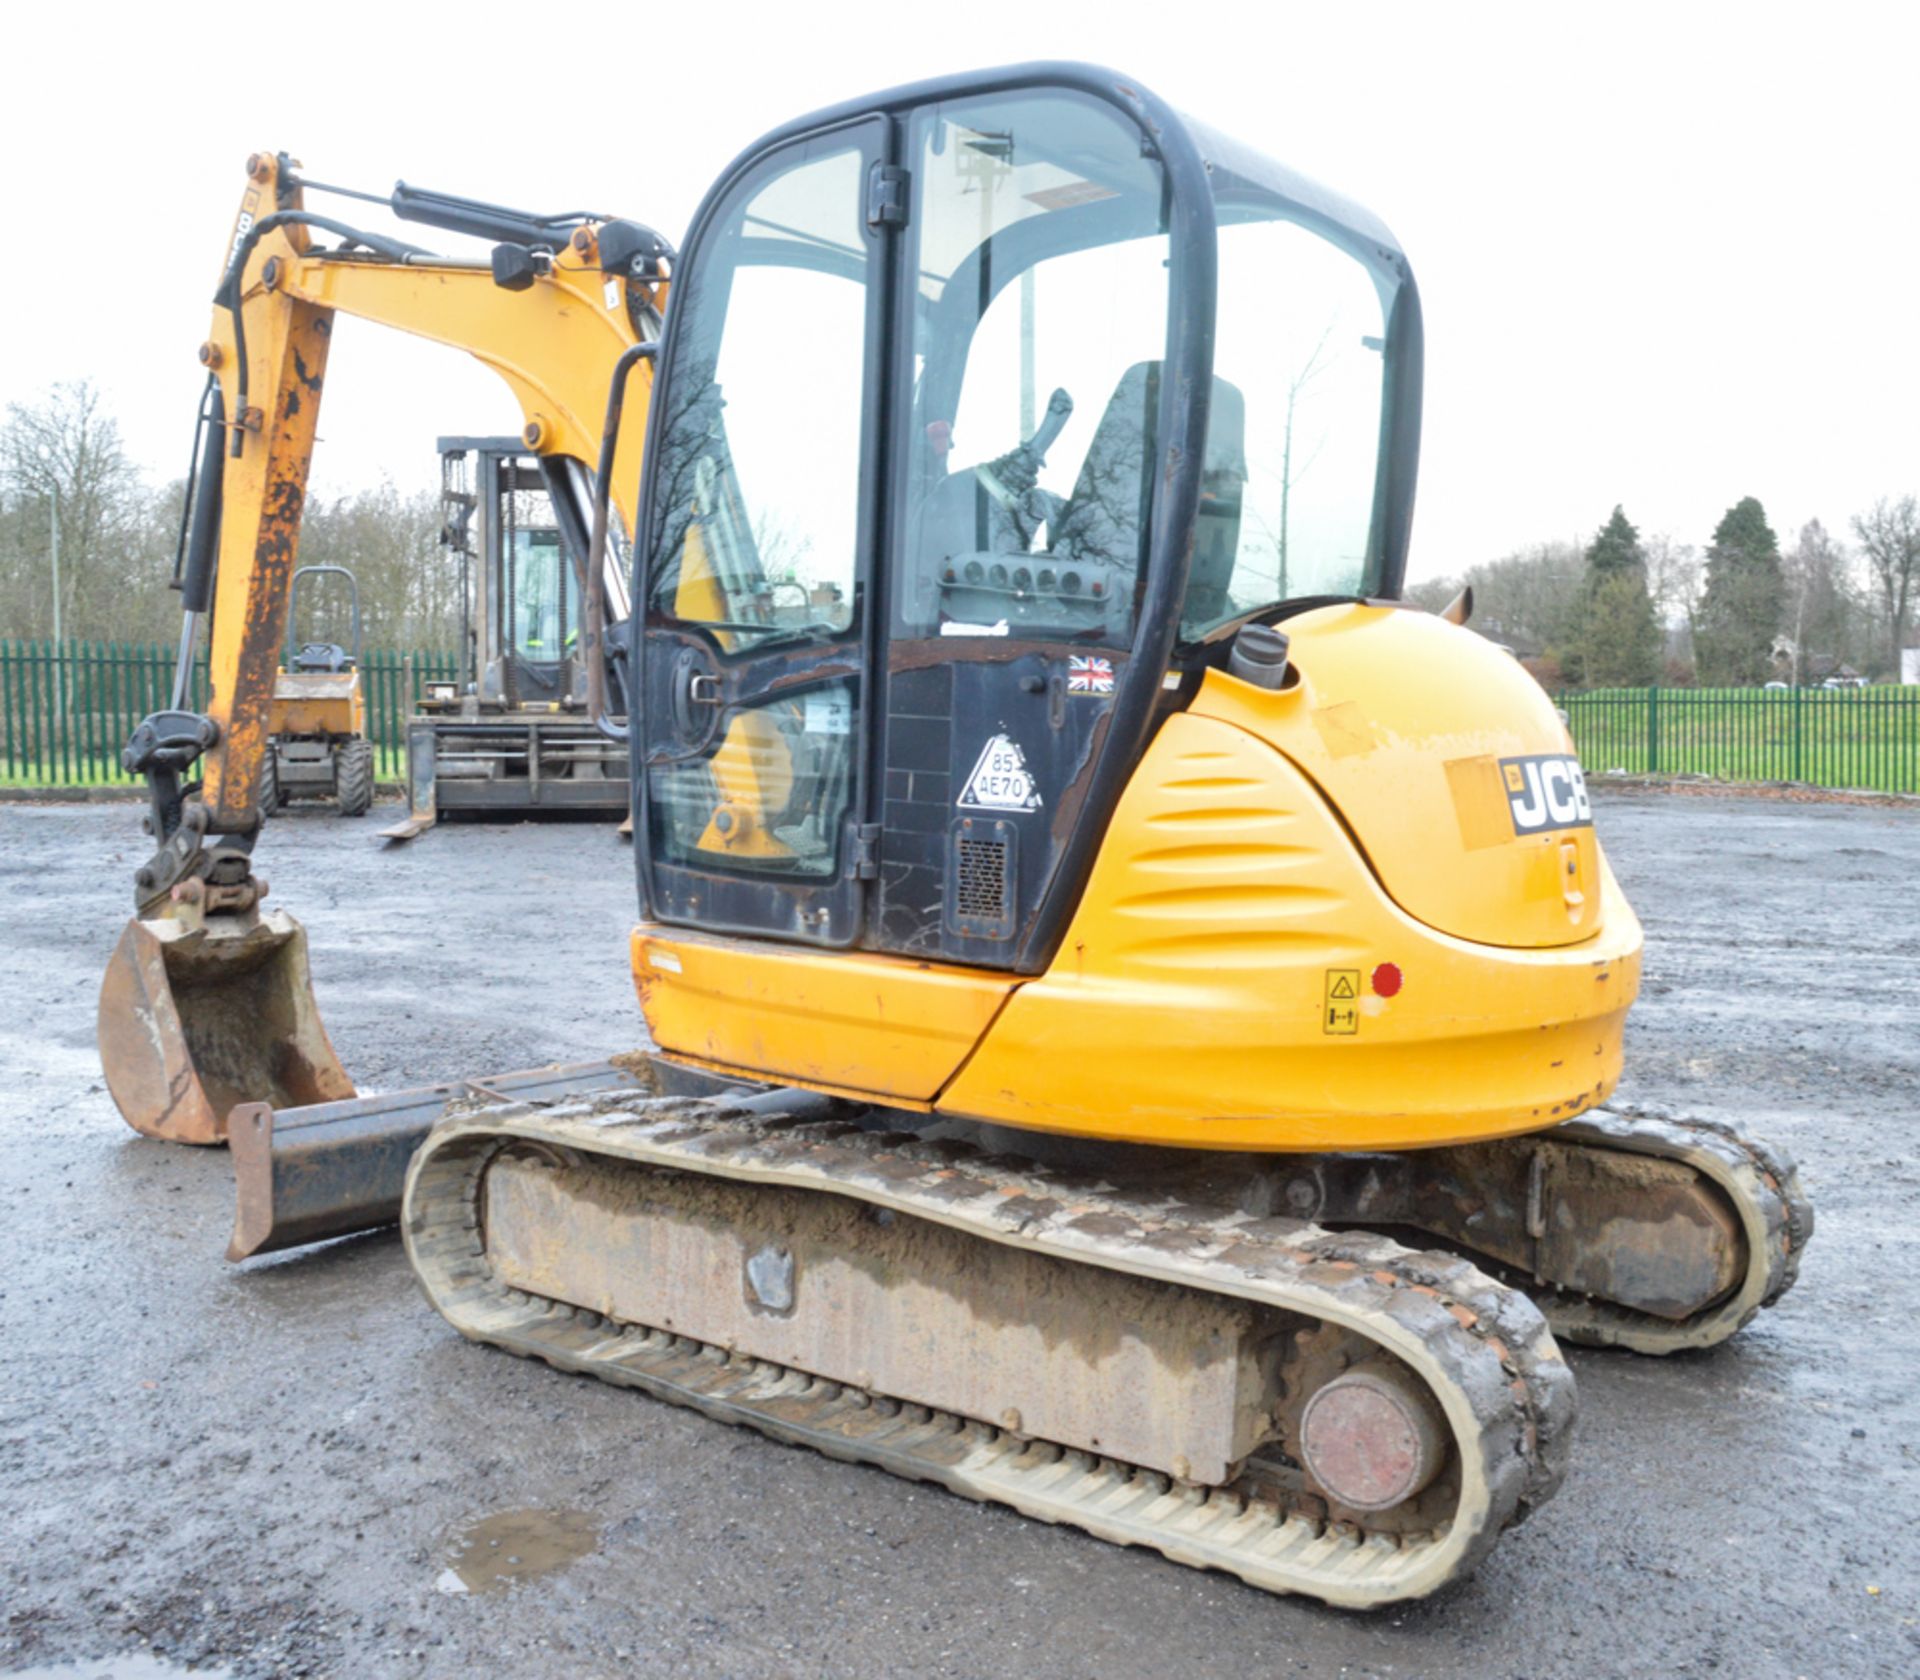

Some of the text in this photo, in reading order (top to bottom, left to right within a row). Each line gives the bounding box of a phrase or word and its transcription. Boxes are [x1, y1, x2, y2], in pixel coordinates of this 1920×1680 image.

[992, 753, 1014, 773] 85
[979, 776, 1023, 798] AE70
[1511, 760, 1592, 828] JCB
